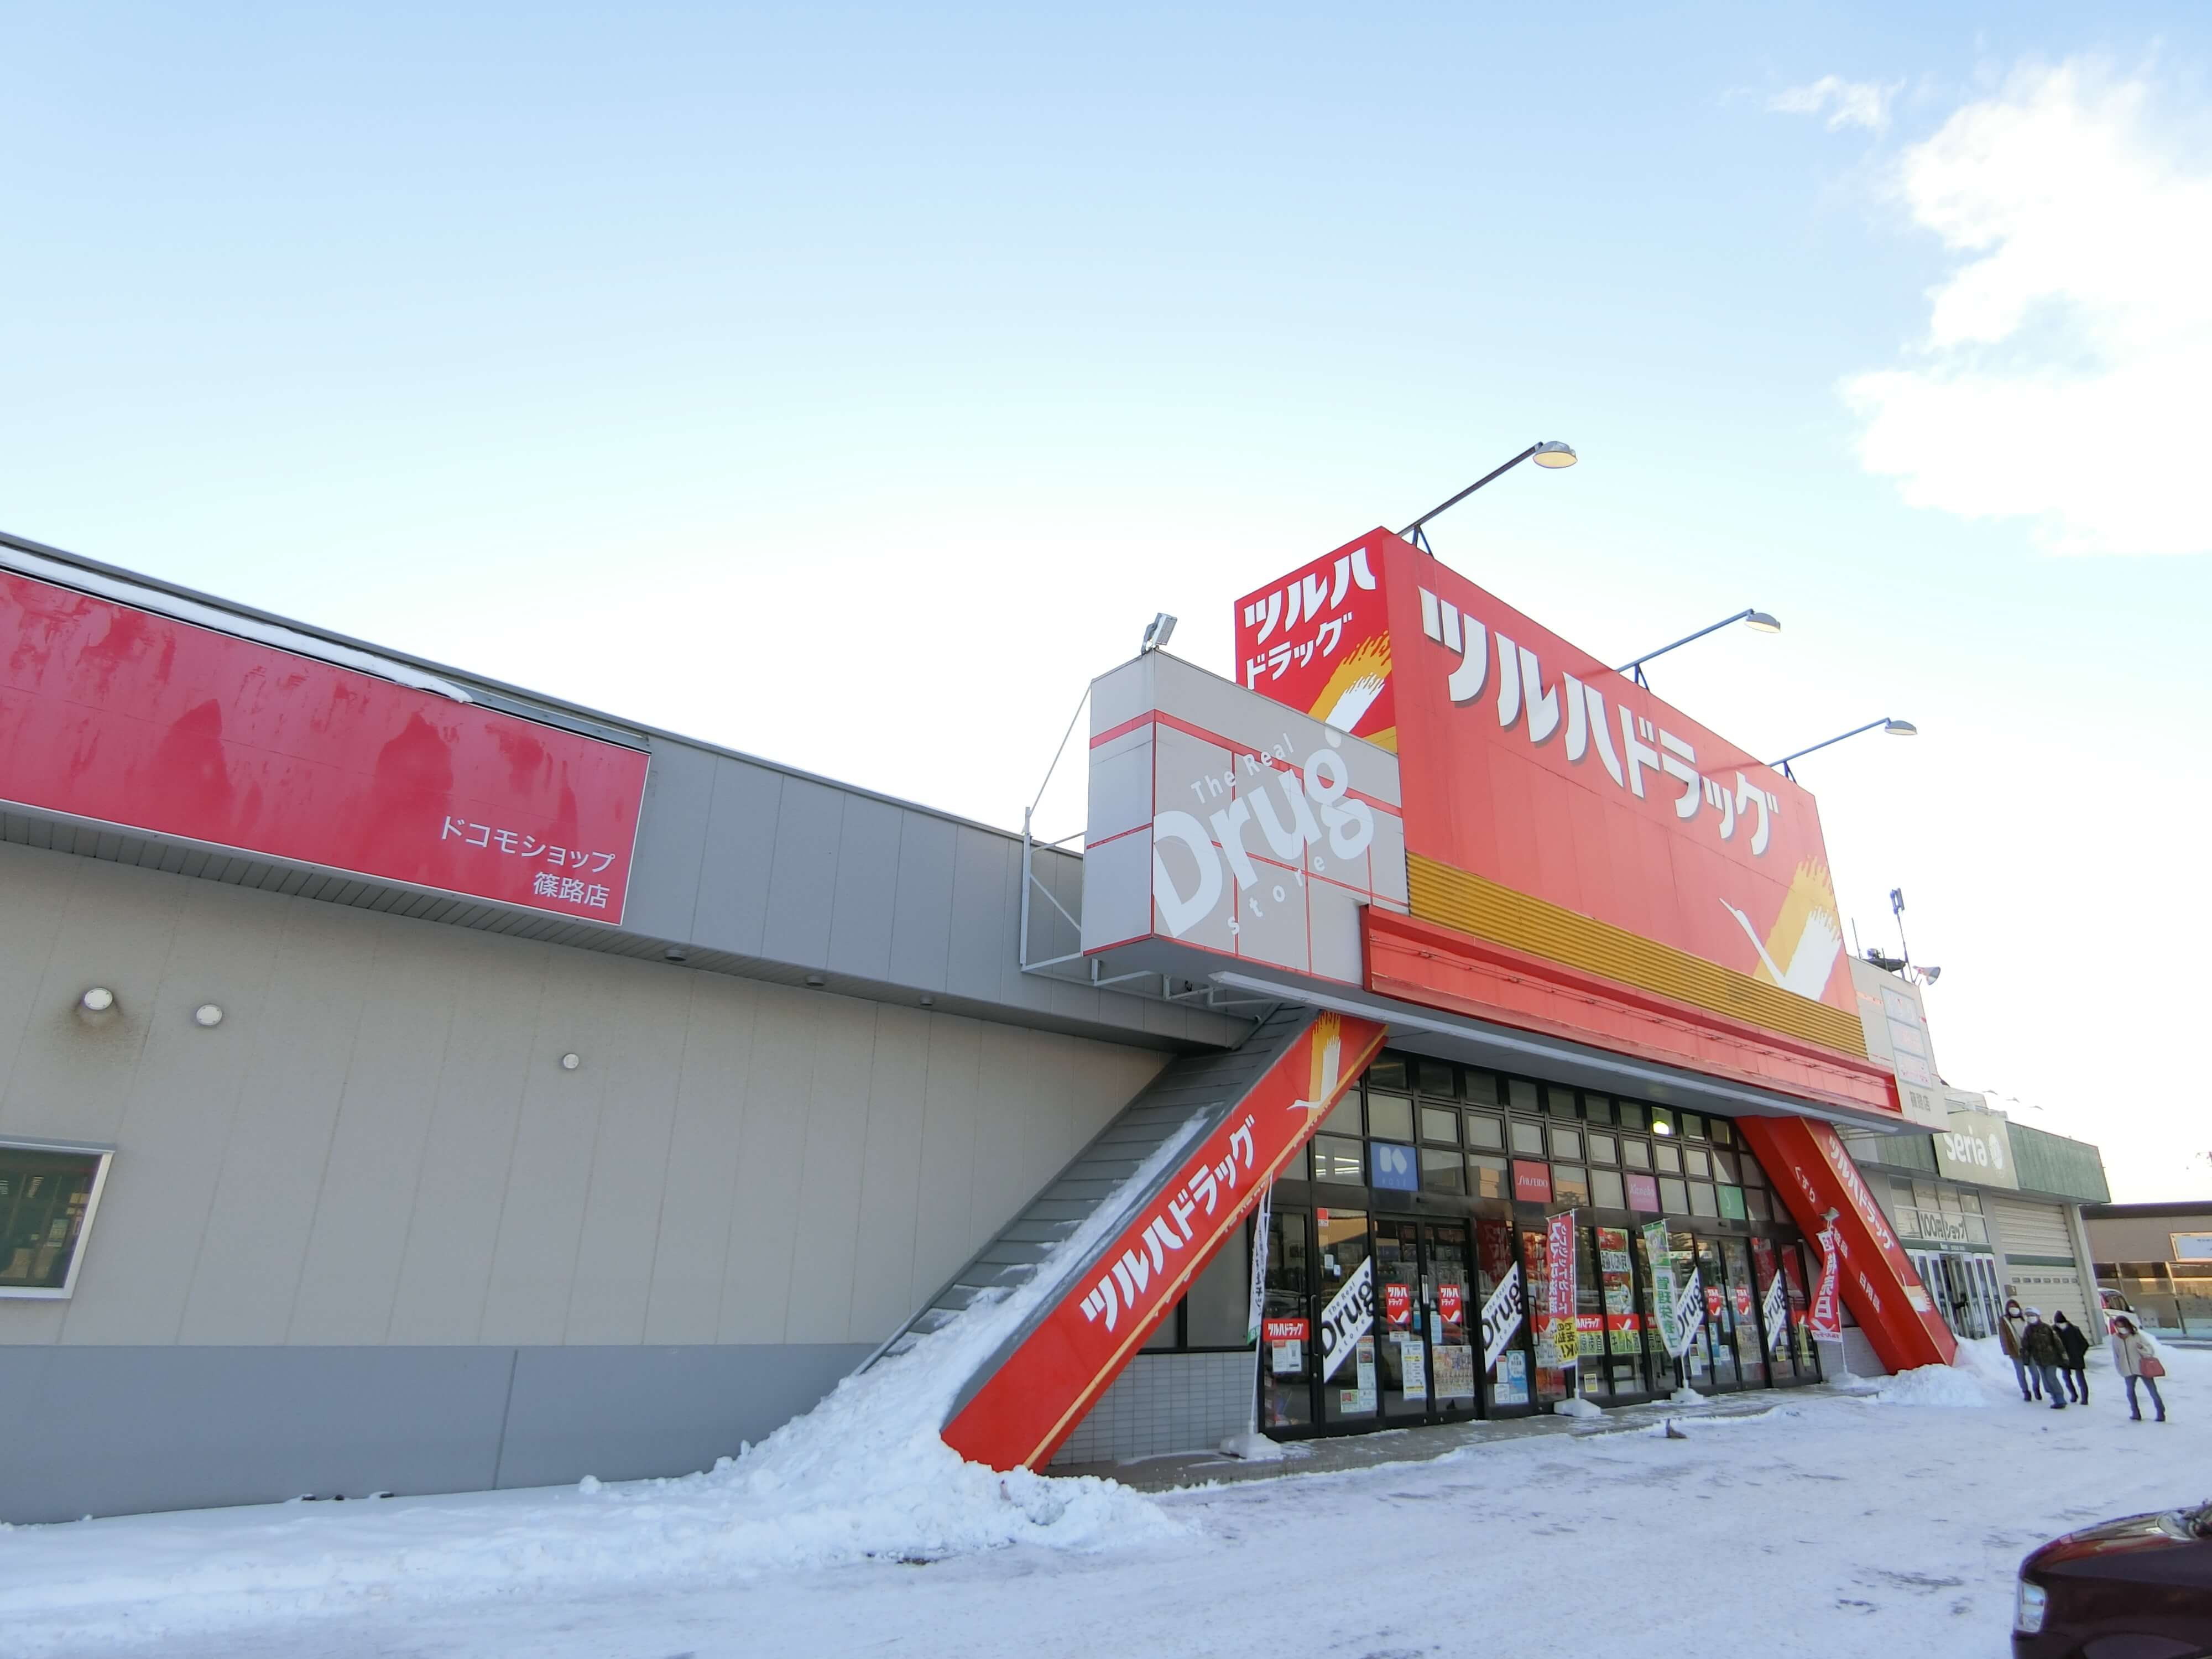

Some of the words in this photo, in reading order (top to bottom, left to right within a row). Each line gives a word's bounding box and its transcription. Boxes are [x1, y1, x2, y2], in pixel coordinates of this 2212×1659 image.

[1244, 547, 1376, 645] ツルハ
[1246, 612, 1353, 690] ドラッグ
[1418, 586, 1779, 855] ツルハドラッグ
[1191, 770, 1235, 804] The
[1243, 733, 1294, 775] Real
[442, 815, 615, 873] ドコモショップ
[1153, 727, 1374, 938] Drug
[534, 872, 609, 908] 篠路店
[1228, 856, 1324, 935] store
[1944, 1125, 1987, 1167] Seria
[1517, 1175, 1548, 1188] SHISEIDO
[1794, 1167, 1815, 1203] くすり
[1829, 1135, 1894, 1249] ツルハドラッグ
[1079, 1114, 1255, 1332] ツルハドラッグ
[1387, 1287, 1407, 1297] ツルハ
[1441, 1287, 1459, 1297] ツルハ
[1267, 1322, 1303, 1336] ツルハドラッグ
